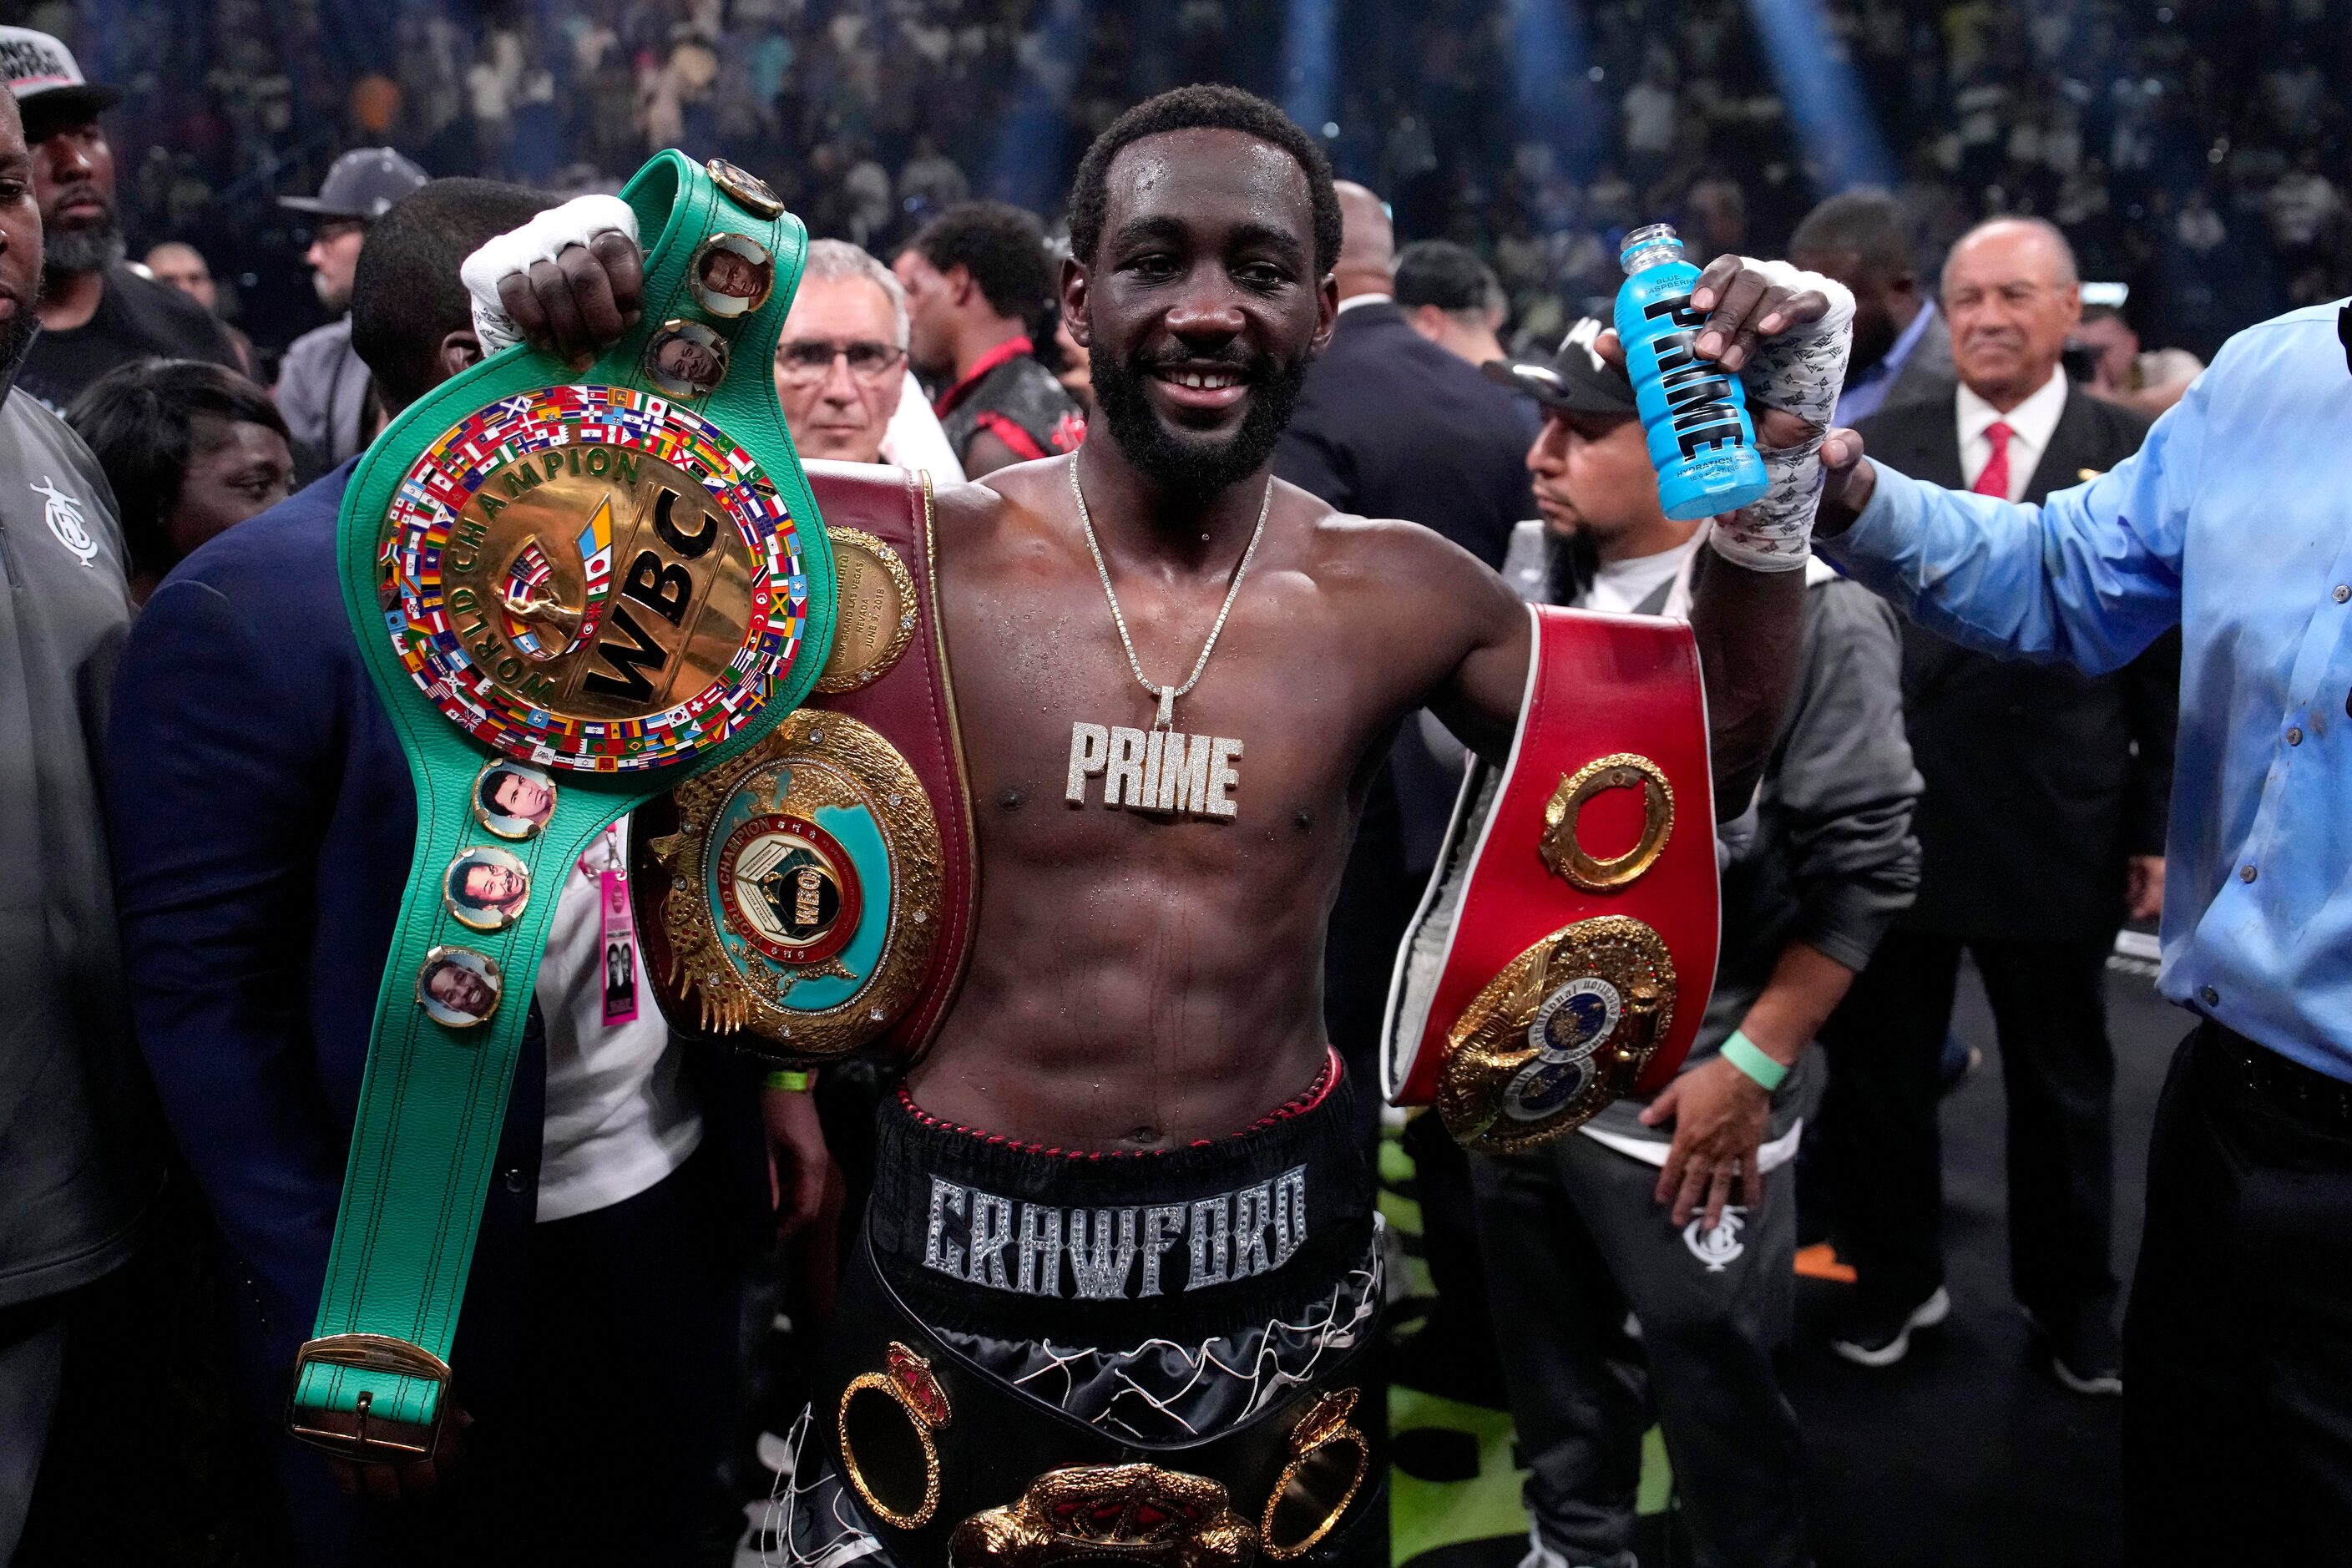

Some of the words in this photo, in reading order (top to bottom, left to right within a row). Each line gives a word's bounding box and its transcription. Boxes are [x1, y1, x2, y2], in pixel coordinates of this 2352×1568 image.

[1656, 274, 1681, 285] BLUE
[1643, 294, 1744, 463] PRIME
[1677, 456, 1733, 478] HYDRATION
[451, 448, 642, 573] CHAMPION
[583, 487, 720, 703] WBC
[848, 592, 857, 609] LAS
[852, 559, 866, 589] VEGAS,
[841, 610, 853, 641] GRAND
[856, 598, 869, 633] NEVADA
[866, 625, 877, 649] JUNE
[873, 588, 885, 611] 2018
[451, 585, 555, 707] WORLD
[836, 642, 847, 665] MGM
[1065, 721, 1245, 821] PRIME
[719, 817, 771, 885] CHAMPION
[722, 890, 763, 948] WORLD
[795, 870, 822, 924] WBO
[922, 1163, 1308, 1300] CRAWFORD
